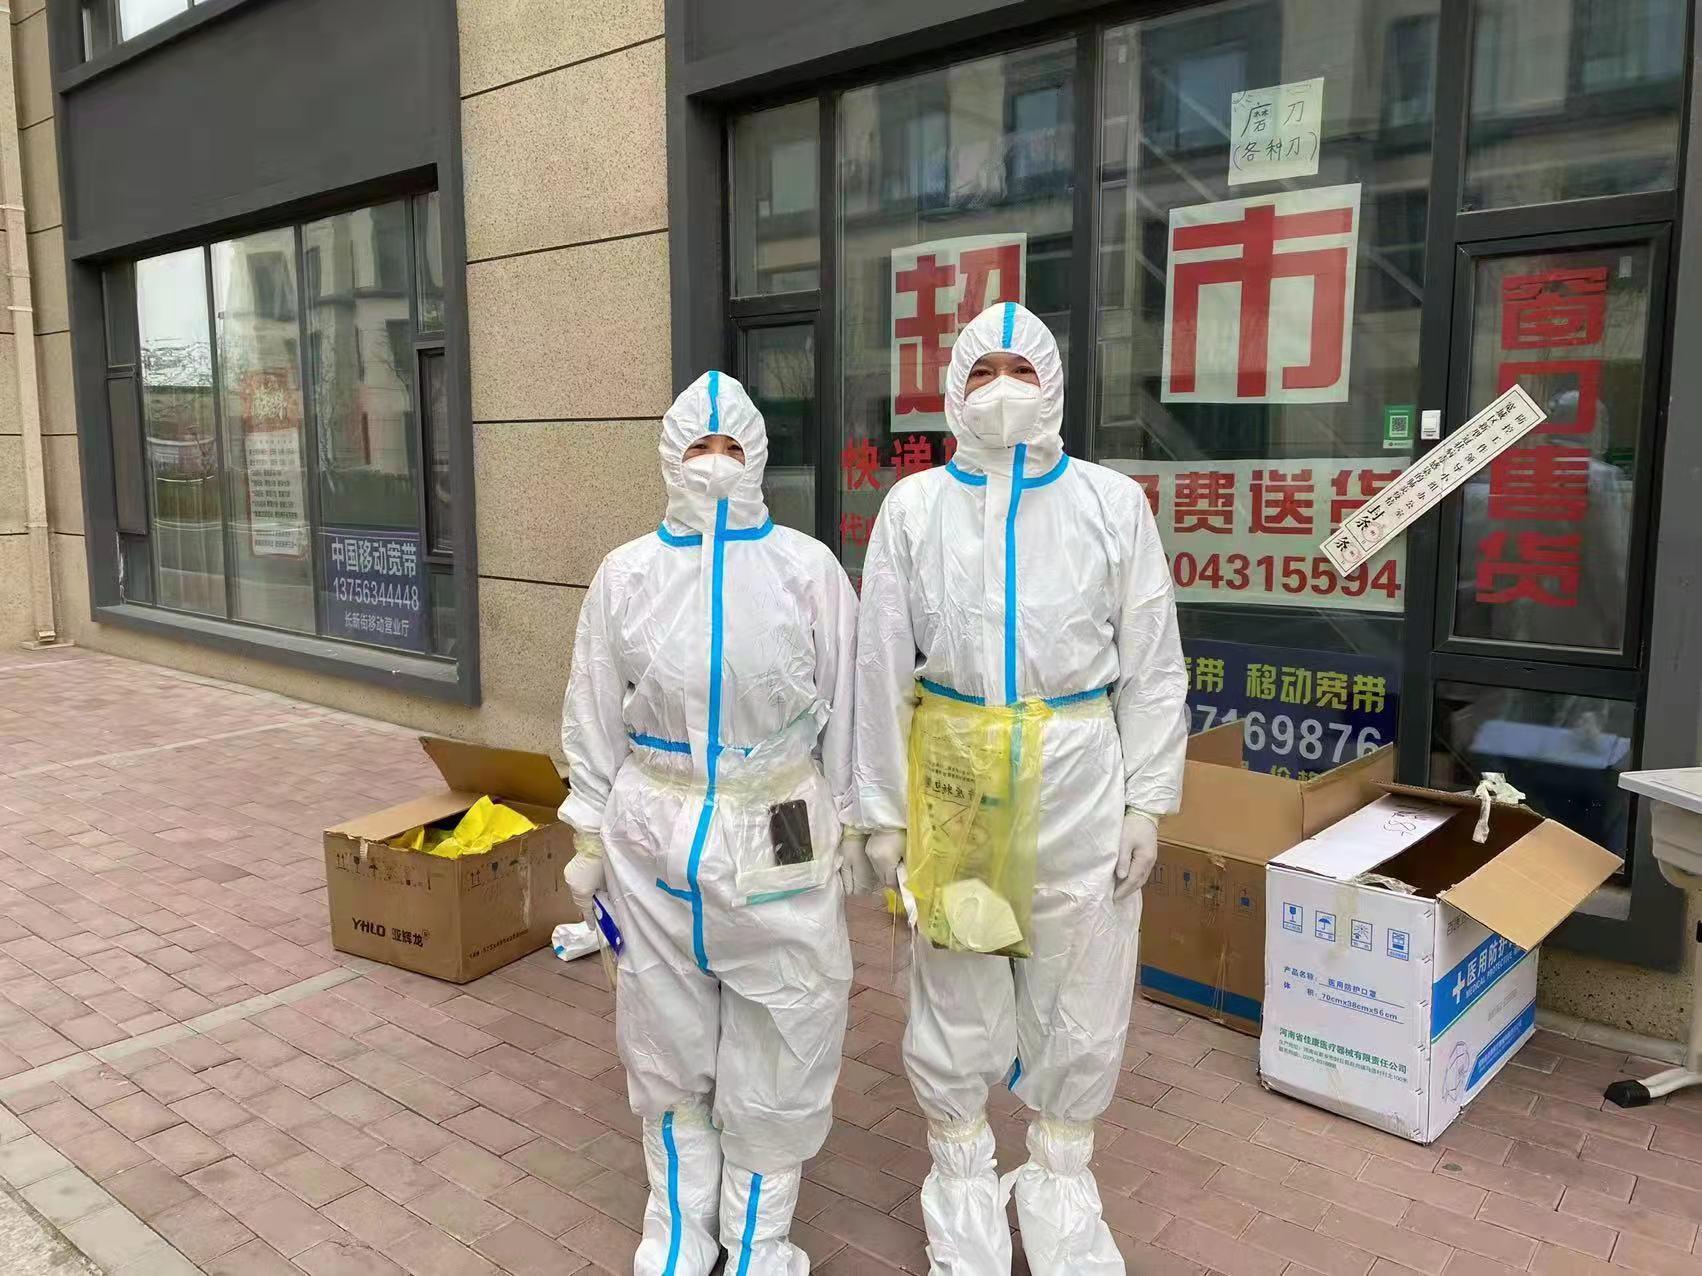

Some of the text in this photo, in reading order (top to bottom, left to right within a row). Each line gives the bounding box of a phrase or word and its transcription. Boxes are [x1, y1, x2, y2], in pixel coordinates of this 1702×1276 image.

[1169, 204, 1354, 398] 市
[841, 434, 957, 490] 快递
[331, 537, 417, 578] 中国移动宽带
[1164, 550, 1402, 599] 04315594
[333, 577, 419, 611] 13756344448
[1184, 656, 1387, 714] 带 移动宽带
[352, 916, 386, 938] YHLO
